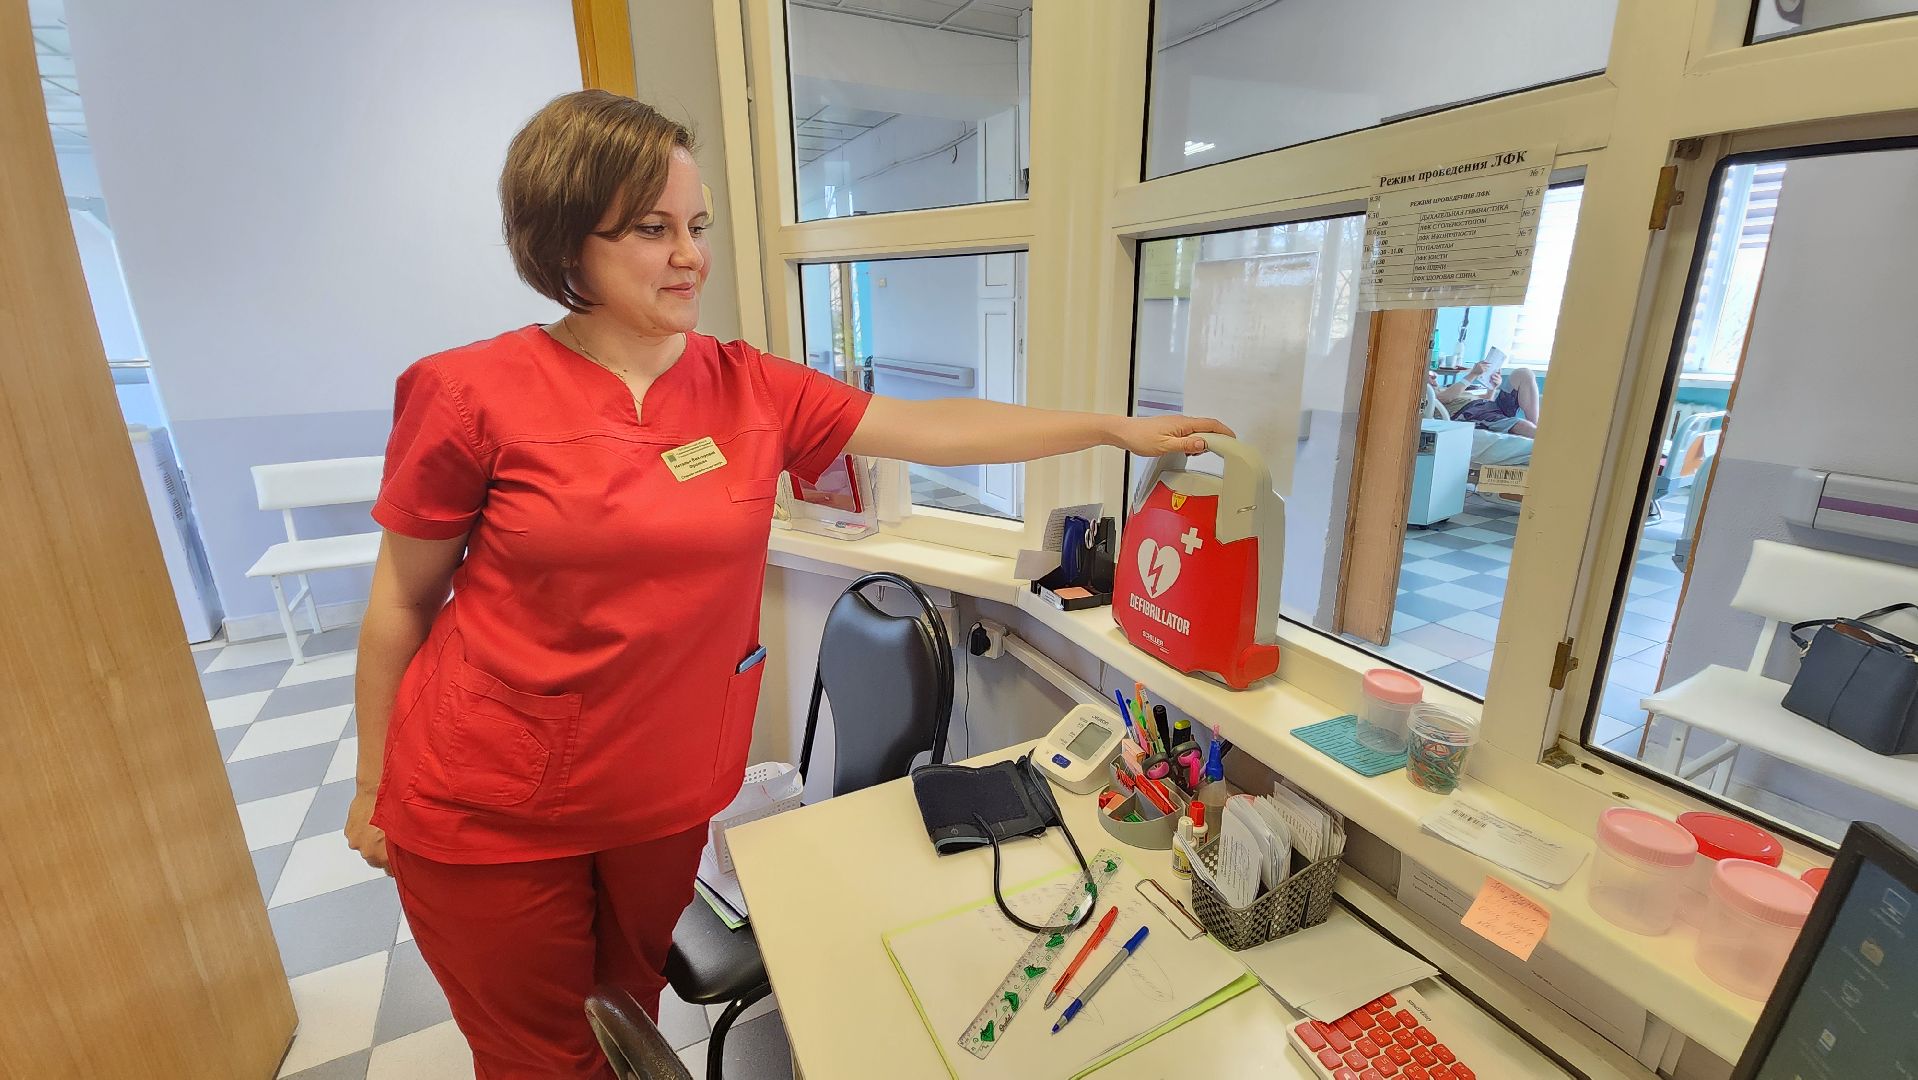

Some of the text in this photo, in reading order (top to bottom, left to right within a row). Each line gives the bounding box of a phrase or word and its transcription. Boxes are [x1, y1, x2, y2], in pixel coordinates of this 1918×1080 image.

[1379, 150, 1528, 187] Режим проведения ЛФК
[1129, 592, 1191, 636] DEFIBRILLATOR
